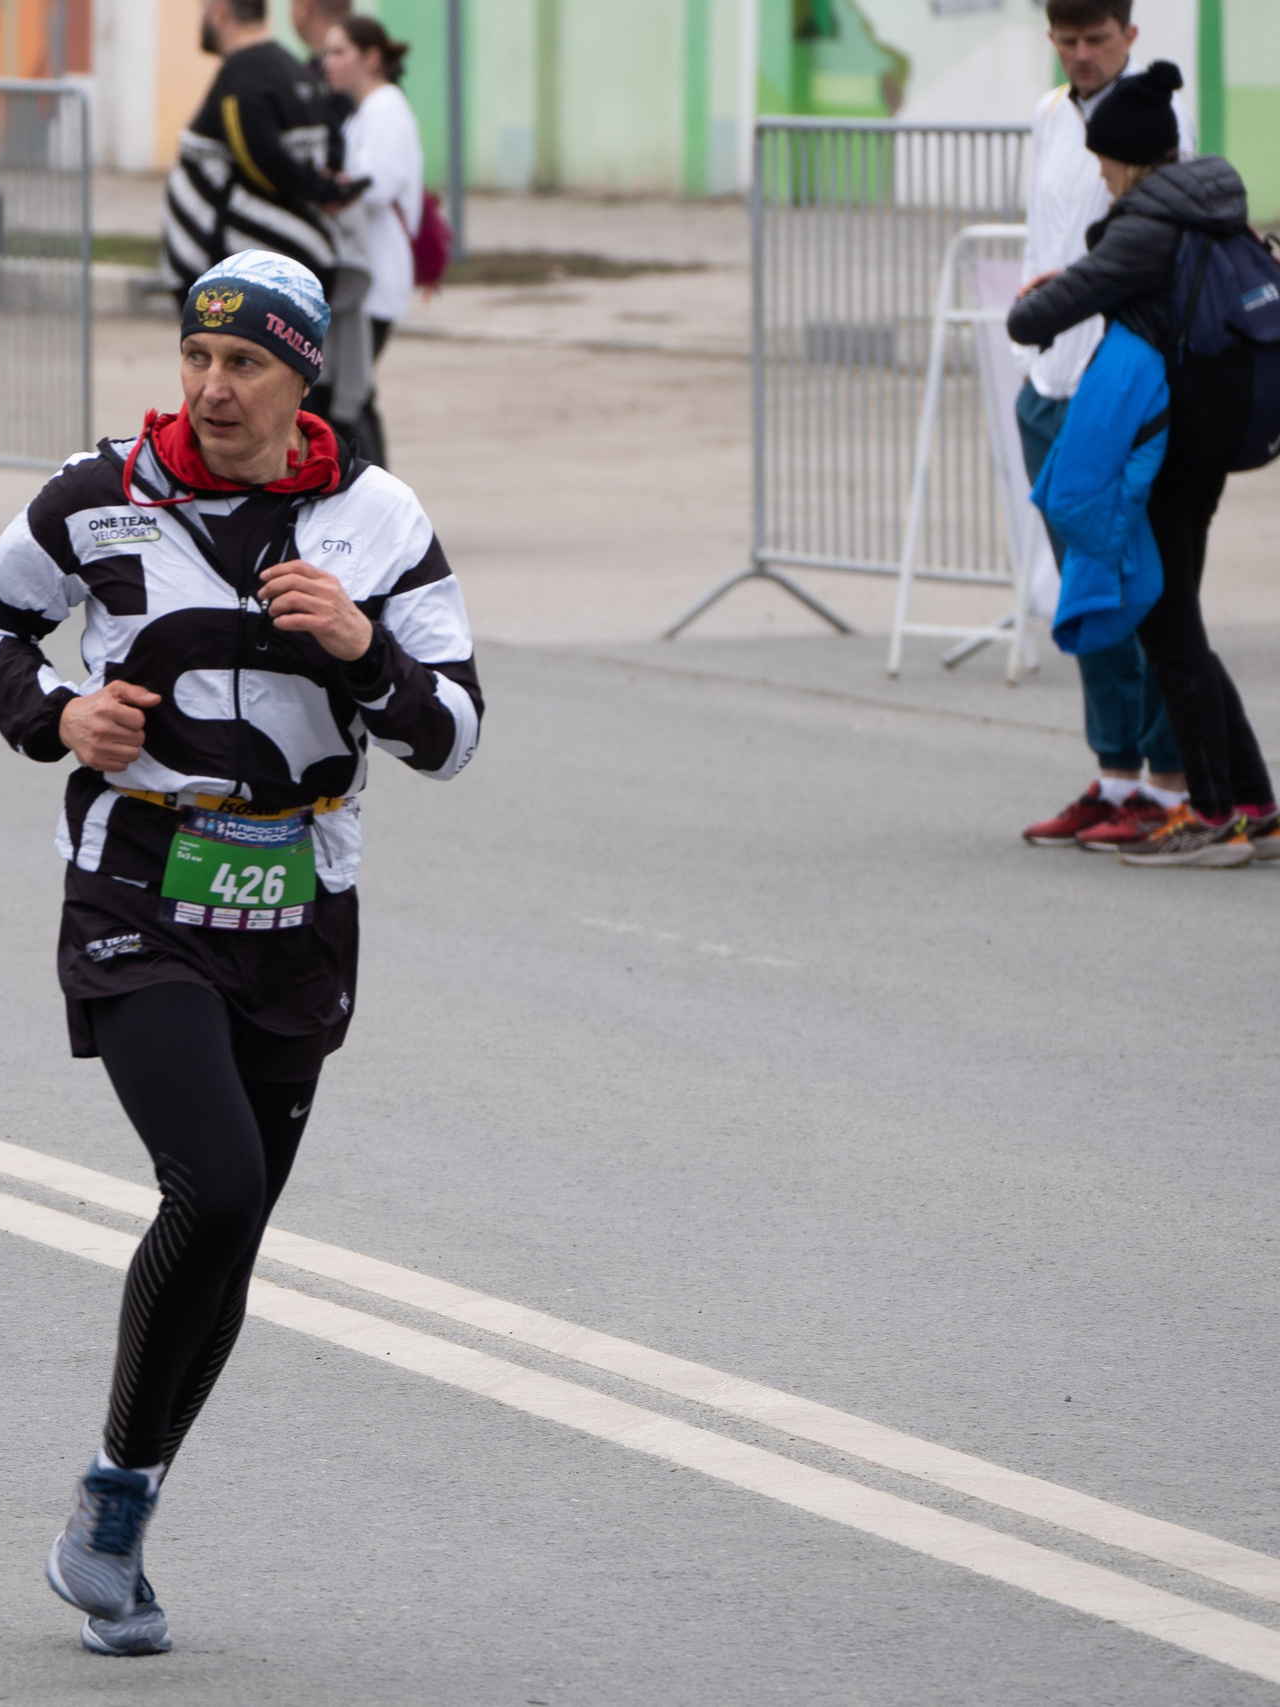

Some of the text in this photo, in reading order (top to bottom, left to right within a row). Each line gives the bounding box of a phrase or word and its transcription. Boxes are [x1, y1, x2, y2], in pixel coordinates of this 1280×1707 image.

[88, 515, 157, 531] ONE TEAM
[91, 527, 151, 542] VELOSPORT
[210, 863, 286, 904] 426
